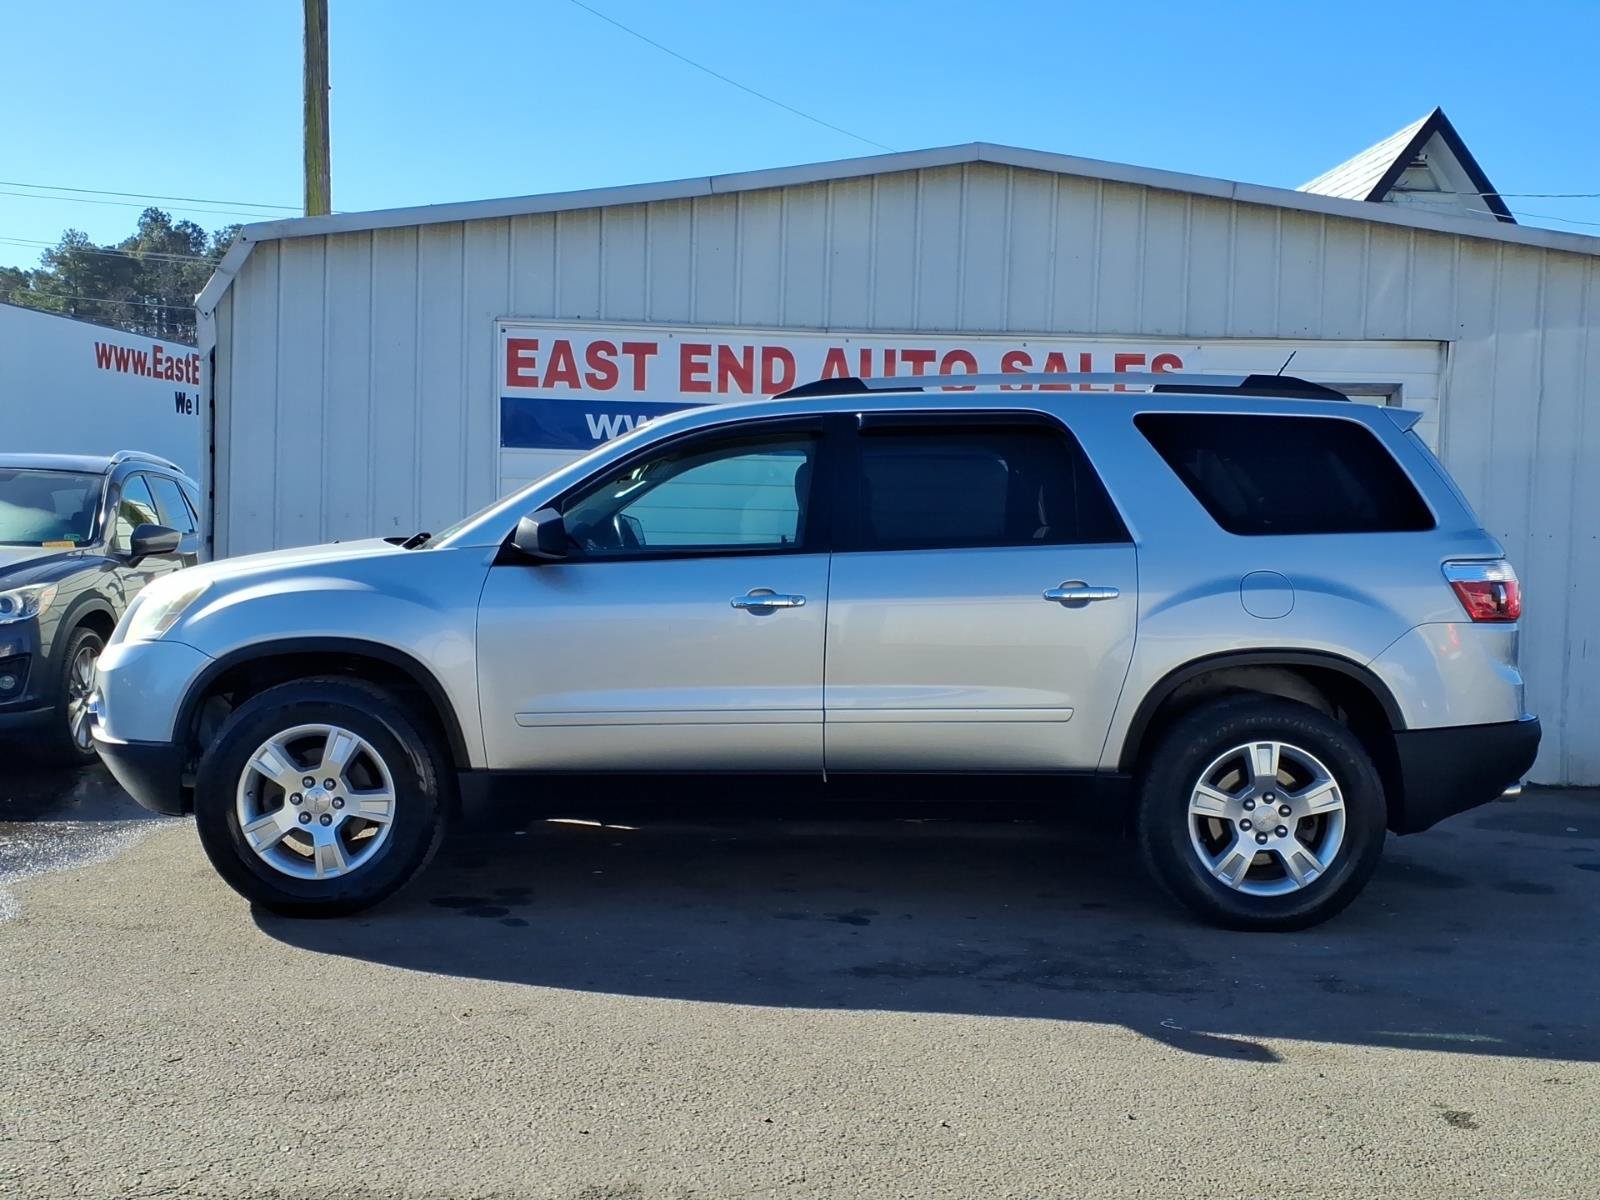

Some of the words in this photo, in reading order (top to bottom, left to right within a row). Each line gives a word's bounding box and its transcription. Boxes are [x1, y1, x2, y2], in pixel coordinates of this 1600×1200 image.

[506, 338, 658, 391] EAST
[680, 343, 797, 395] END
[820, 347, 979, 392] AUTO
[175, 391, 192, 415] We
